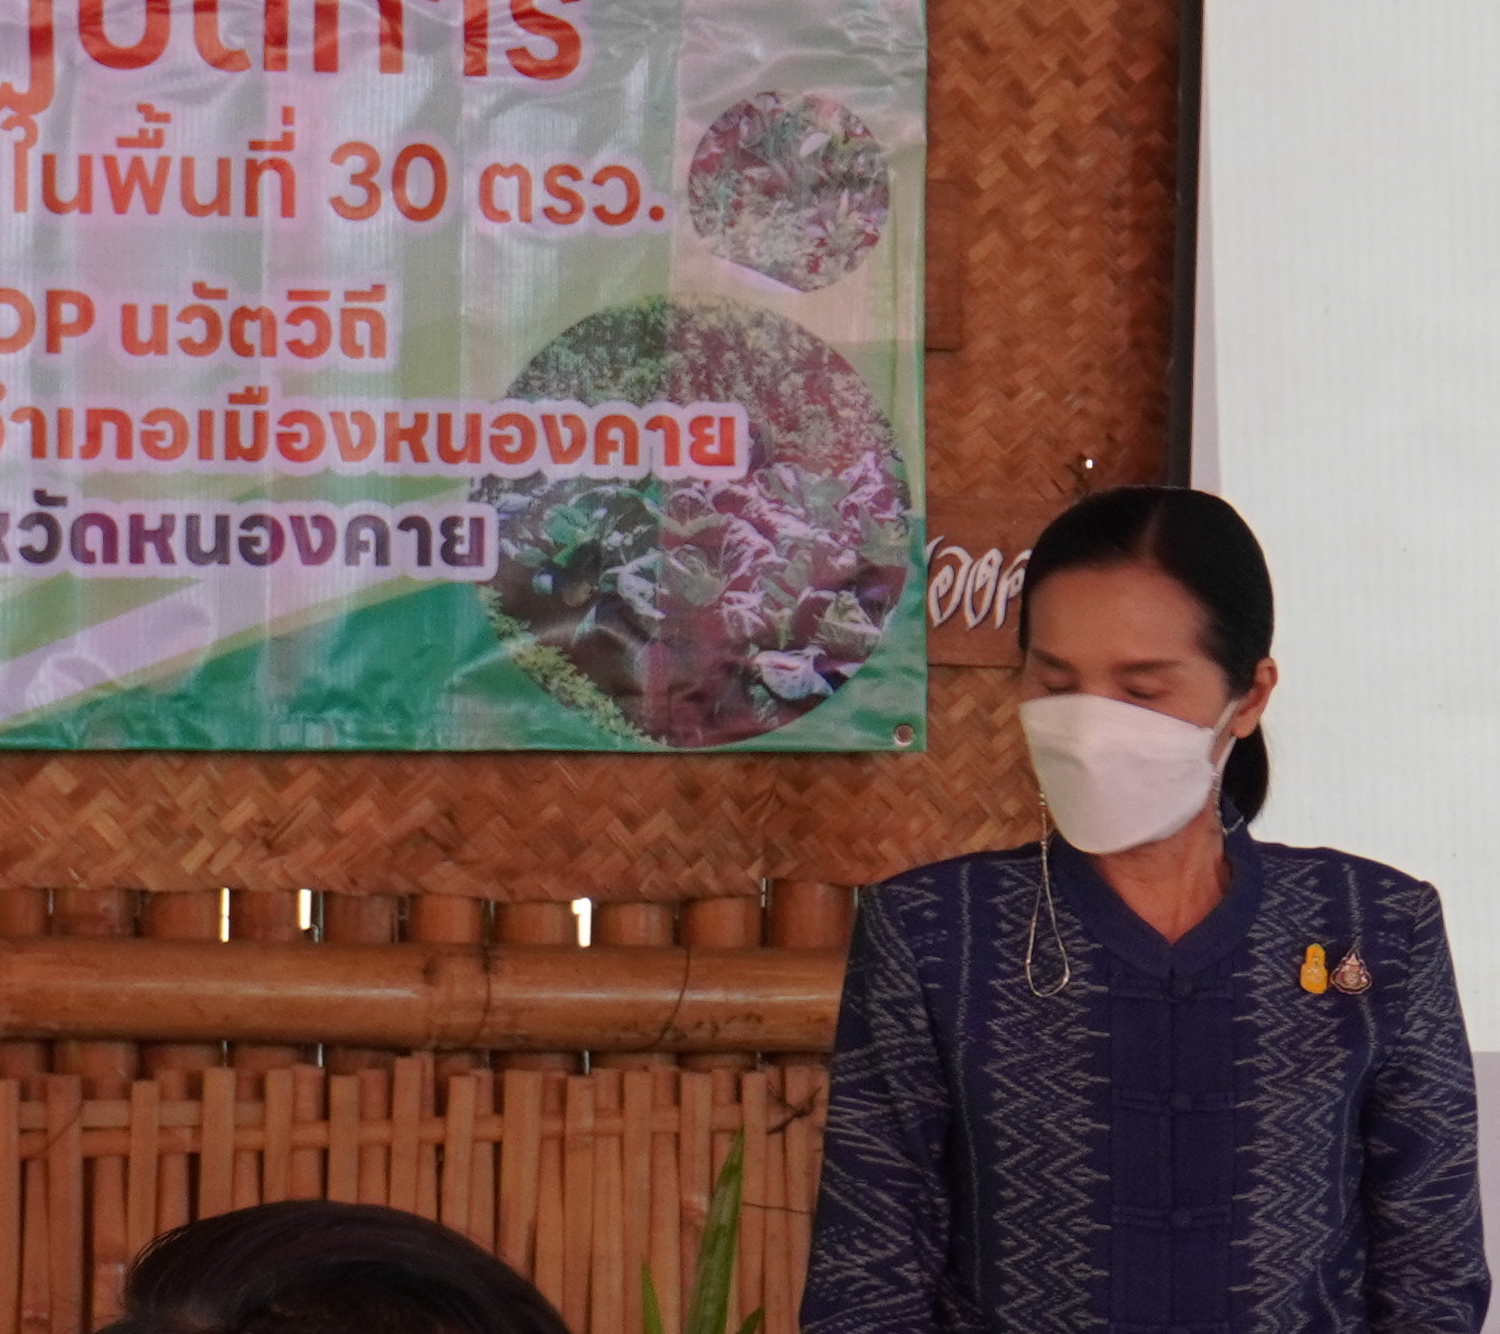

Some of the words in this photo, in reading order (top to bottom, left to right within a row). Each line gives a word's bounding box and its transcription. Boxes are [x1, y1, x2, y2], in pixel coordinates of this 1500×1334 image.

[329, 142, 448, 223] 30
[478, 161, 666, 226] ตรว.
[119, 280, 387, 360] นวัตวิถี
